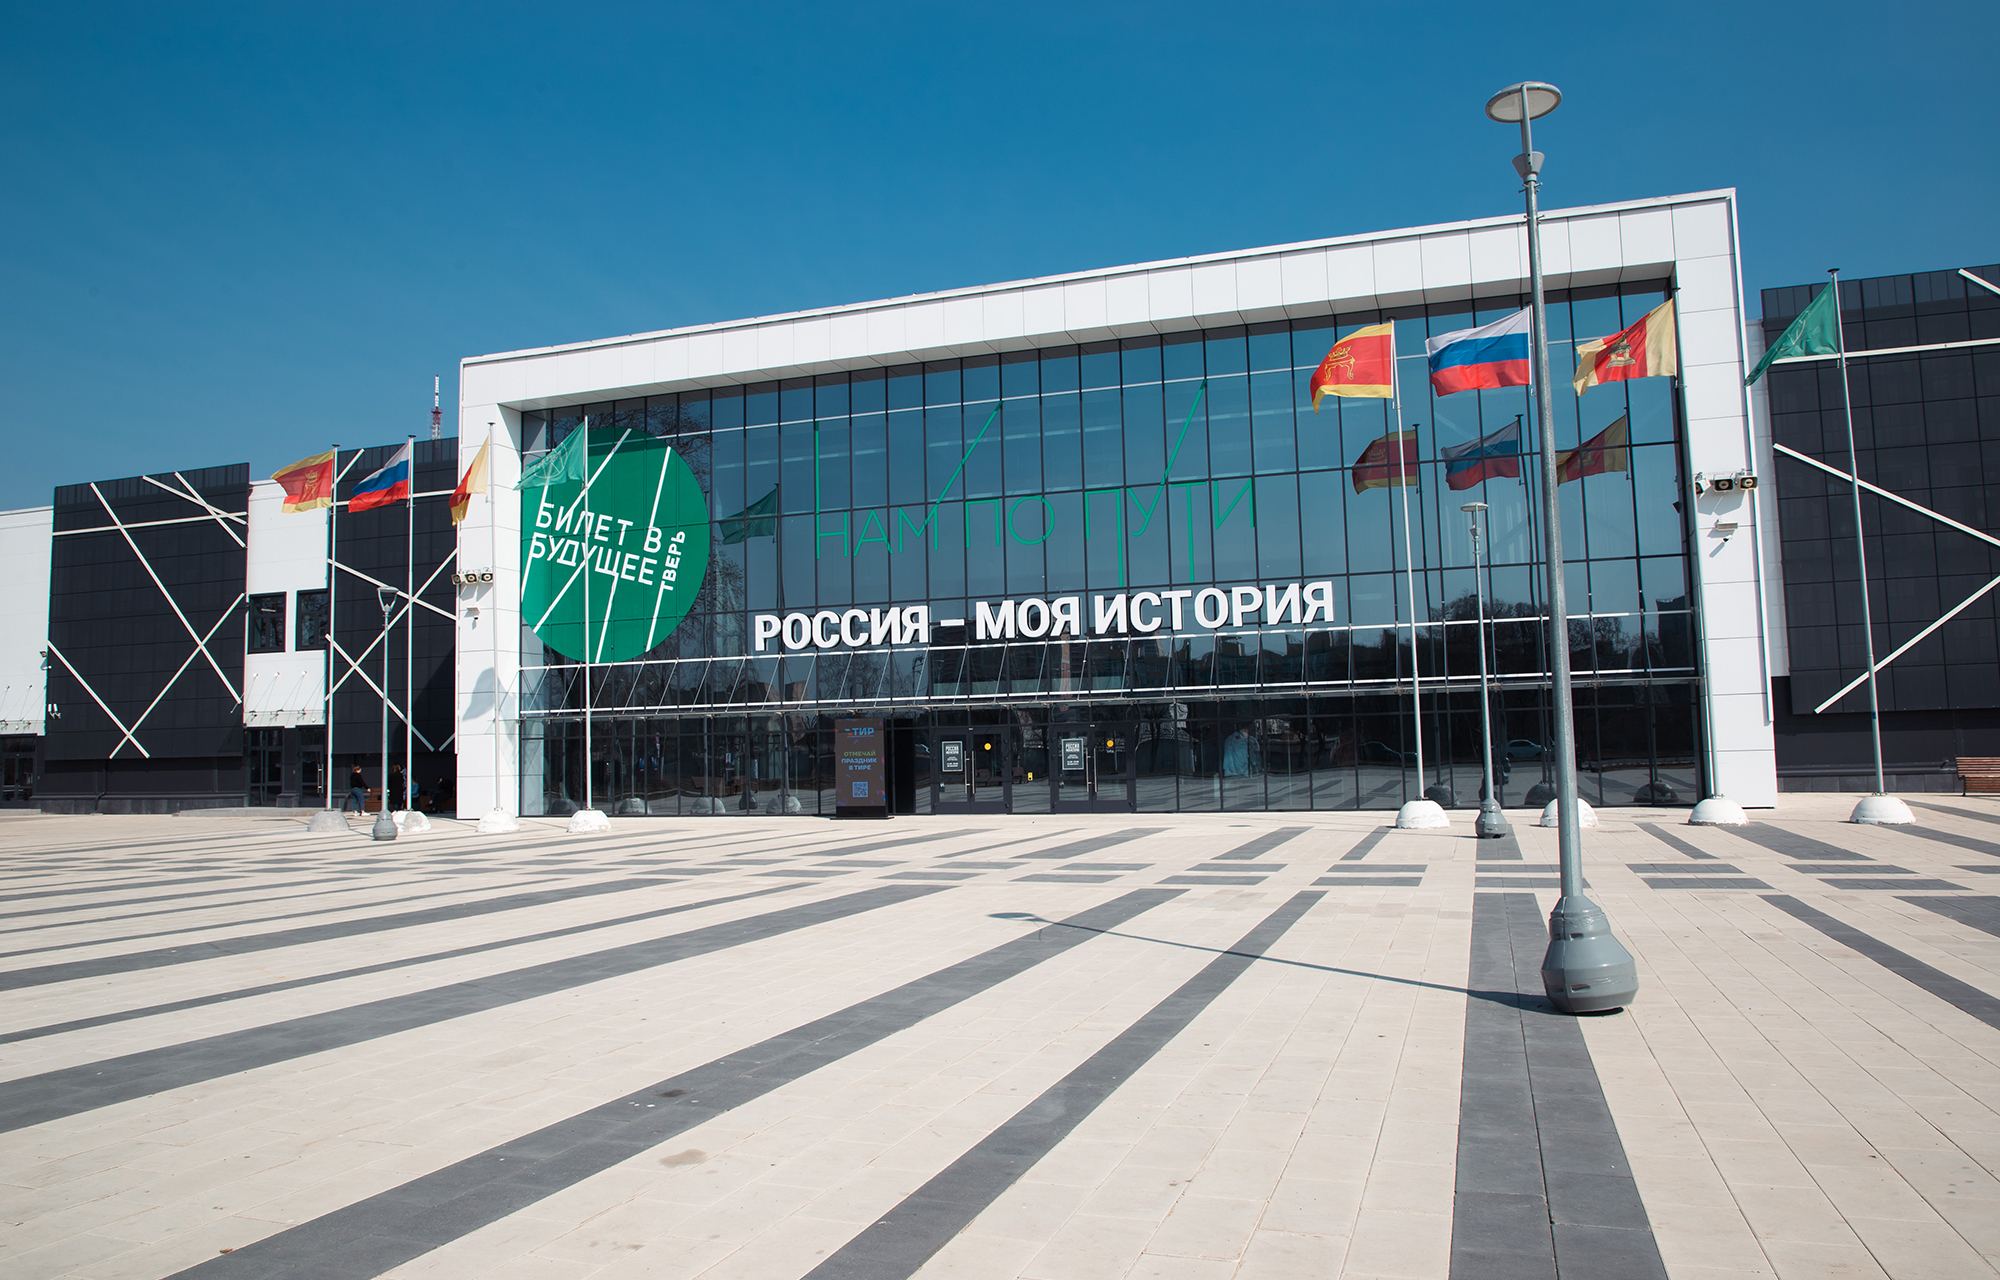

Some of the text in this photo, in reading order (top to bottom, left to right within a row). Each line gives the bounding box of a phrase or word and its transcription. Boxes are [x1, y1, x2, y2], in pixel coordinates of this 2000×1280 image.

[535, 502, 662, 554] БИЛЕТ В
[965, 494, 1056, 549] ПО
[1084, 477, 1256, 588] ПУТИ
[531, 532, 658, 586] БУДУЩЕЕ
[661, 530, 686, 591] ТВЕРЬ
[754, 605, 929, 652] РОССИЯ
[975, 596, 1081, 640] МОЯ
[1094, 580, 1334, 636] ИСТОРИЯ
[852, 727, 875, 736] ТИР
